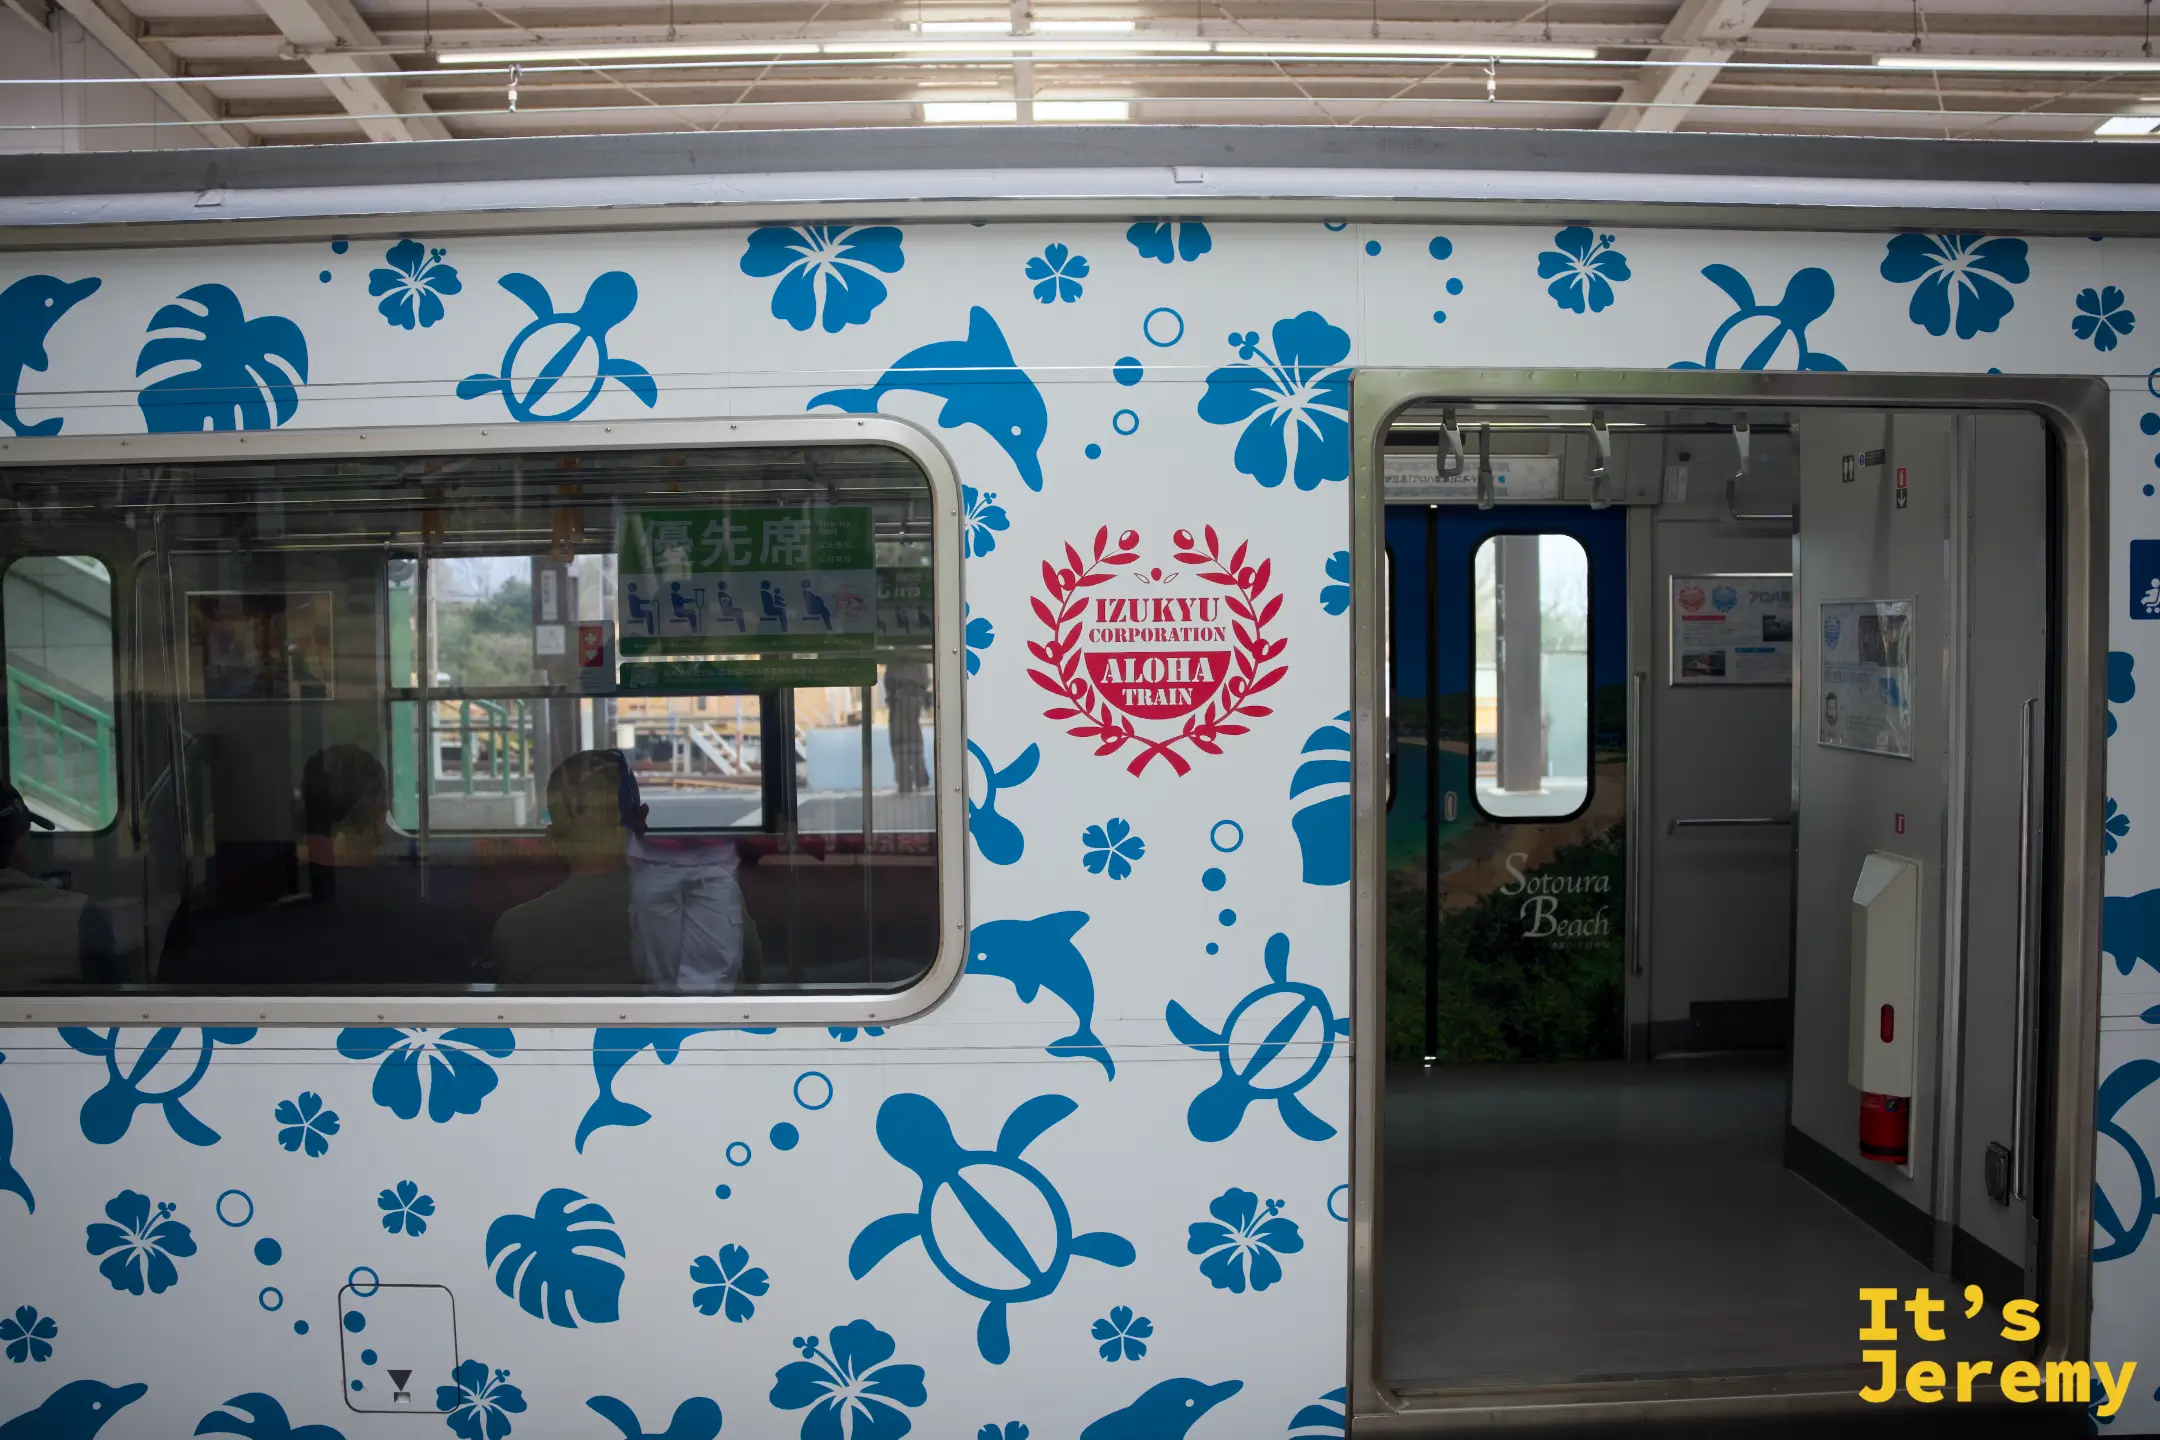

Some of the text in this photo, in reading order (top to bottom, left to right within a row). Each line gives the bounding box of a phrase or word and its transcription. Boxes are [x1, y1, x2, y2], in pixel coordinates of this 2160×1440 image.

[643, 517, 811, 568] 優先席
[1096, 597, 1220, 623] IZUKYU
[1088, 626, 1227, 643] CORPORATION
[1100, 656, 1215, 684] ALOHA
[1122, 687, 1193, 706] TRAIN
[1500, 852, 1611, 895] Sotoura
[1520, 895, 1610, 938] Beach
